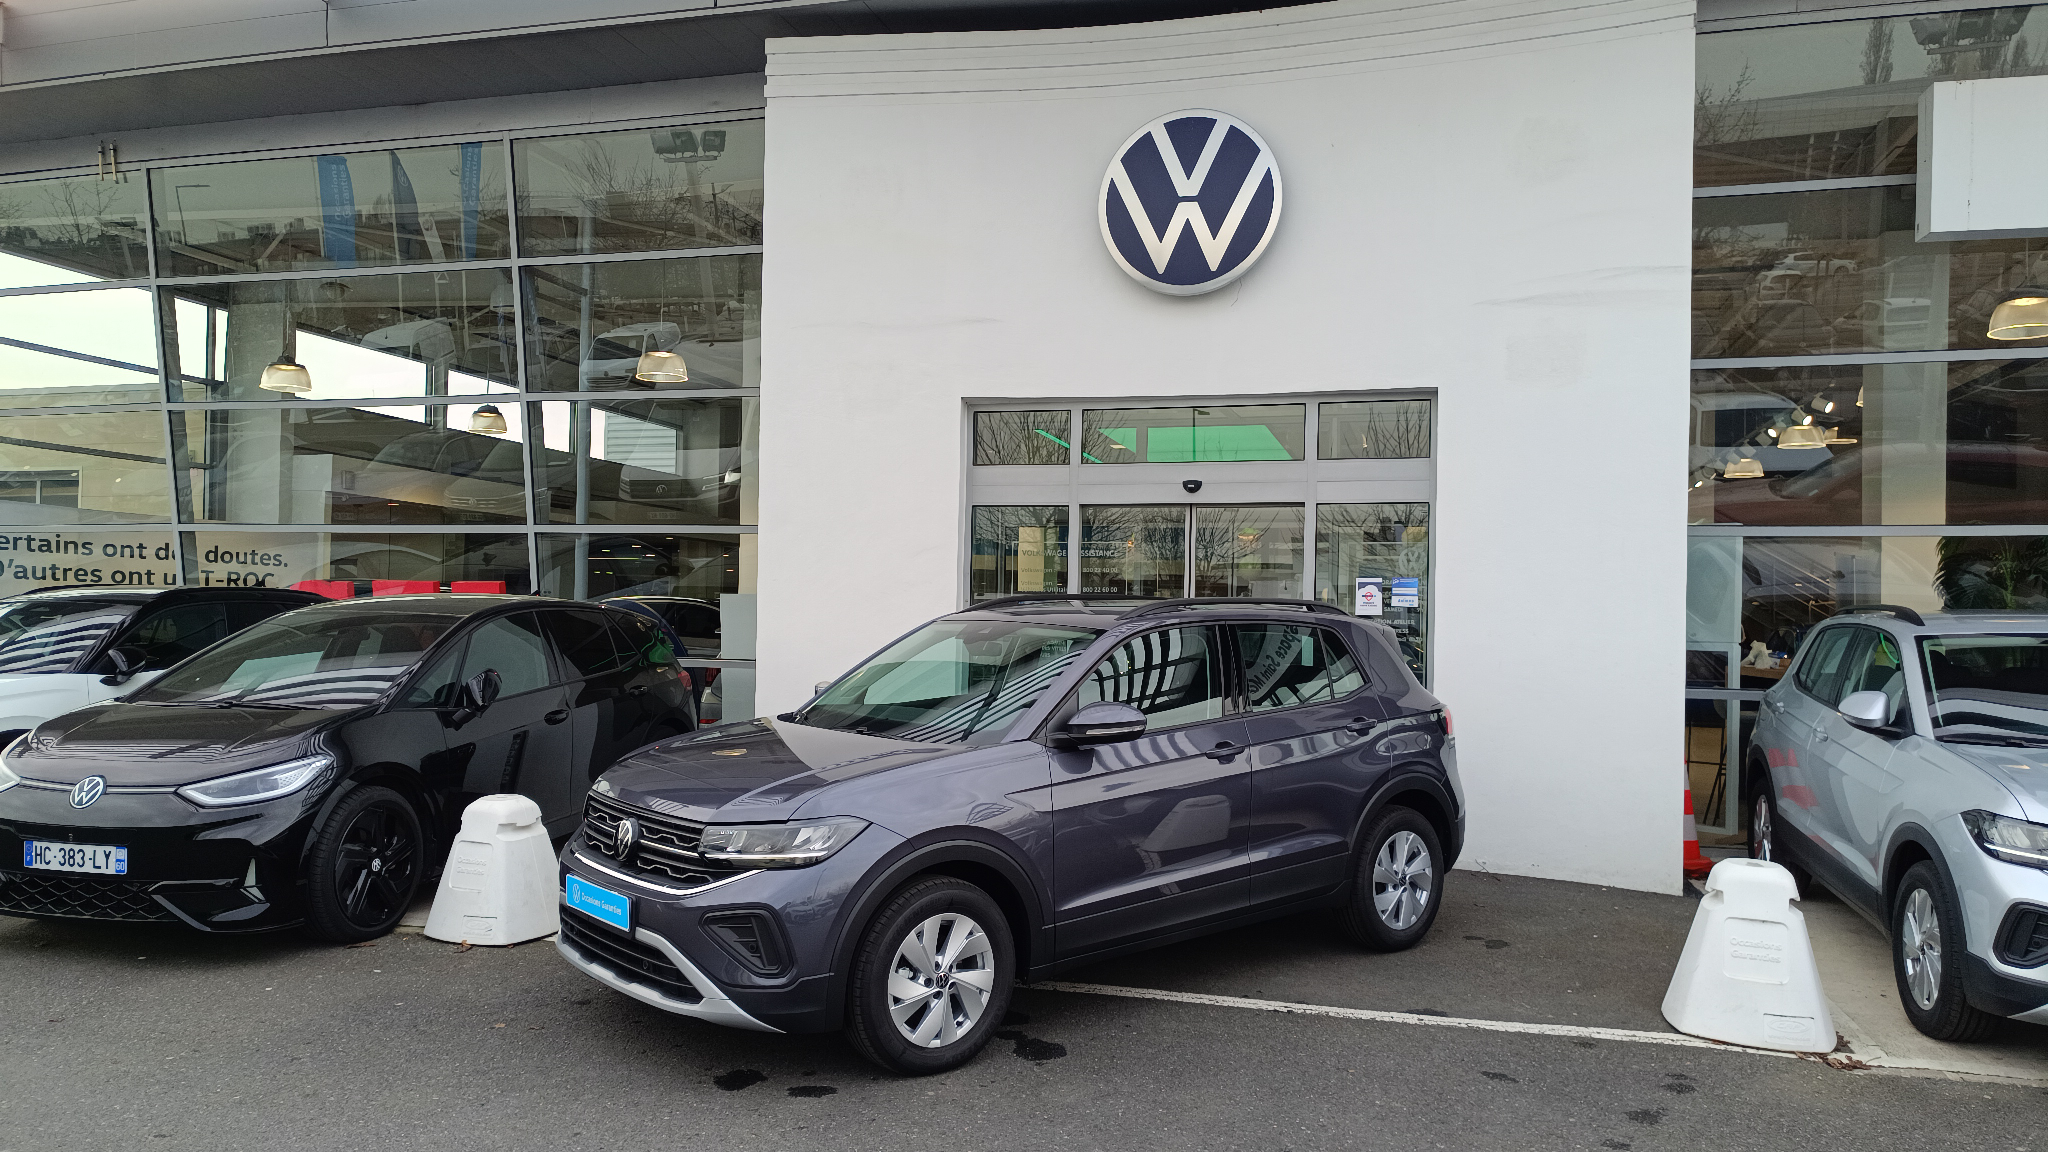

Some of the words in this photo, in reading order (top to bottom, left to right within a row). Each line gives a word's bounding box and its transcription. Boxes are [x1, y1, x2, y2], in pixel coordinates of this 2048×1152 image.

[0, 534, 94, 556] ertains
[102, 543, 147, 560] ont
[205, 545, 288, 568] doutes.
[1081, 549, 1118, 557] SSISTANCE
[111, 570, 156, 586] ont
[164, 573, 177, 586] u
[34, 844, 112, 870] HC-383-LY
[116, 861, 125, 871] 60
